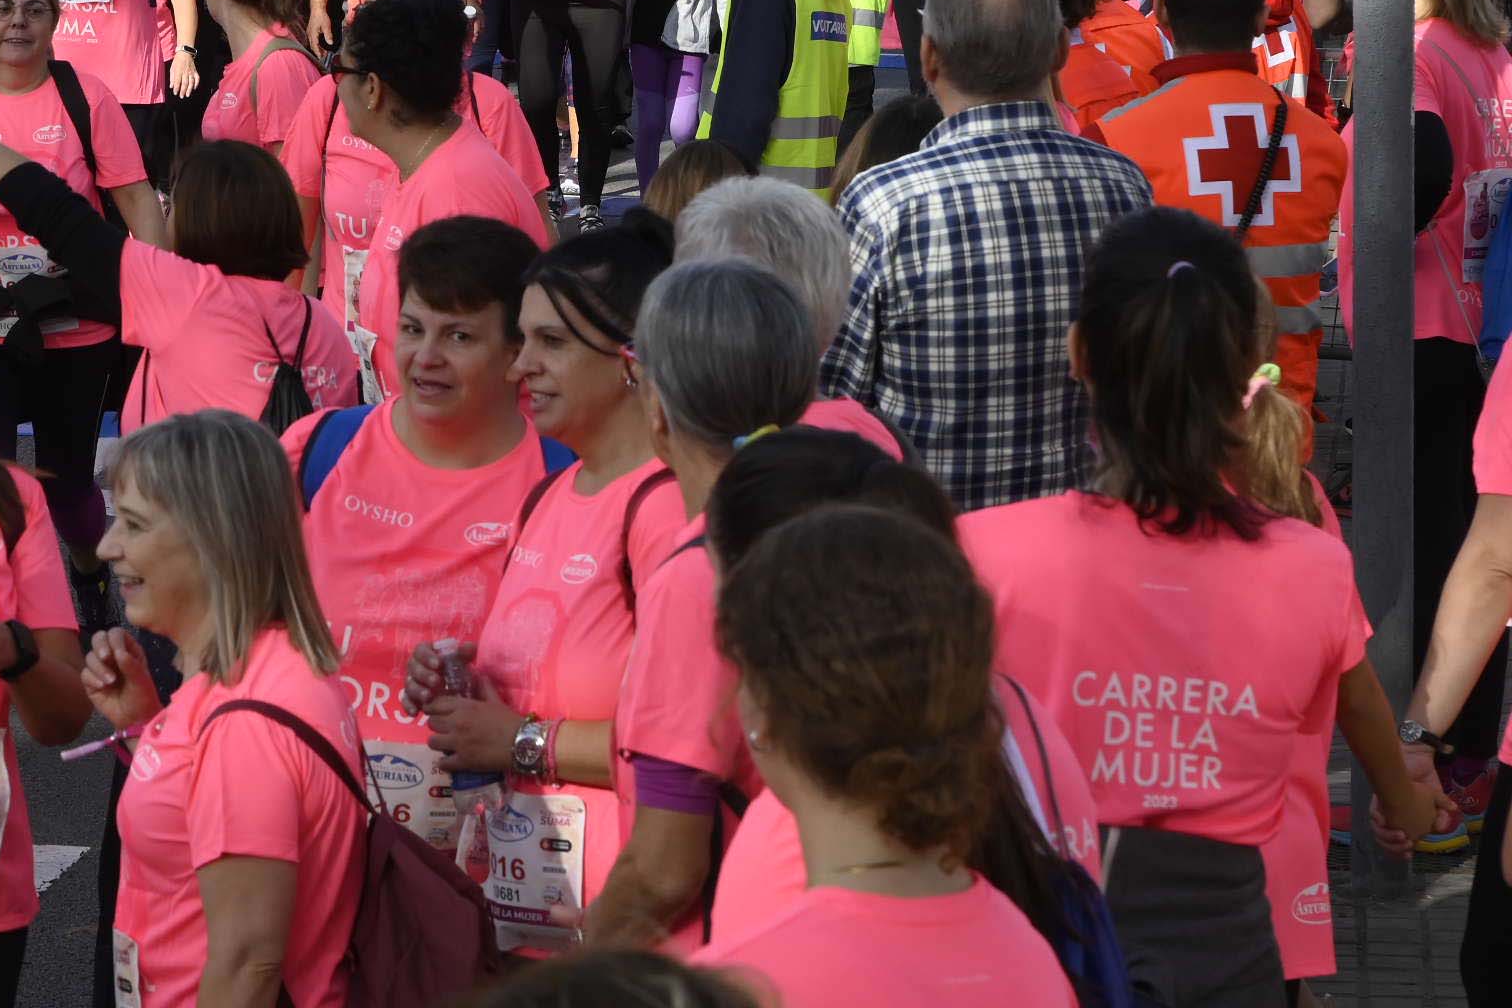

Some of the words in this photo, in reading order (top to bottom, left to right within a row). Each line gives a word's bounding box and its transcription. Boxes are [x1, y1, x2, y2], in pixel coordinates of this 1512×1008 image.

[335, 211, 368, 240] TU
[343, 494, 415, 529] OYSHO
[1072, 670, 1261, 719] CARRERA
[1103, 712, 1154, 749] DE
[1170, 714, 1218, 753] LA
[1090, 751, 1223, 791] MUJER
[1142, 794, 1179, 809] 2023
[539, 815, 572, 827] SUMA
[501, 907, 513, 919] LA
[514, 910, 543, 923] MUJER
